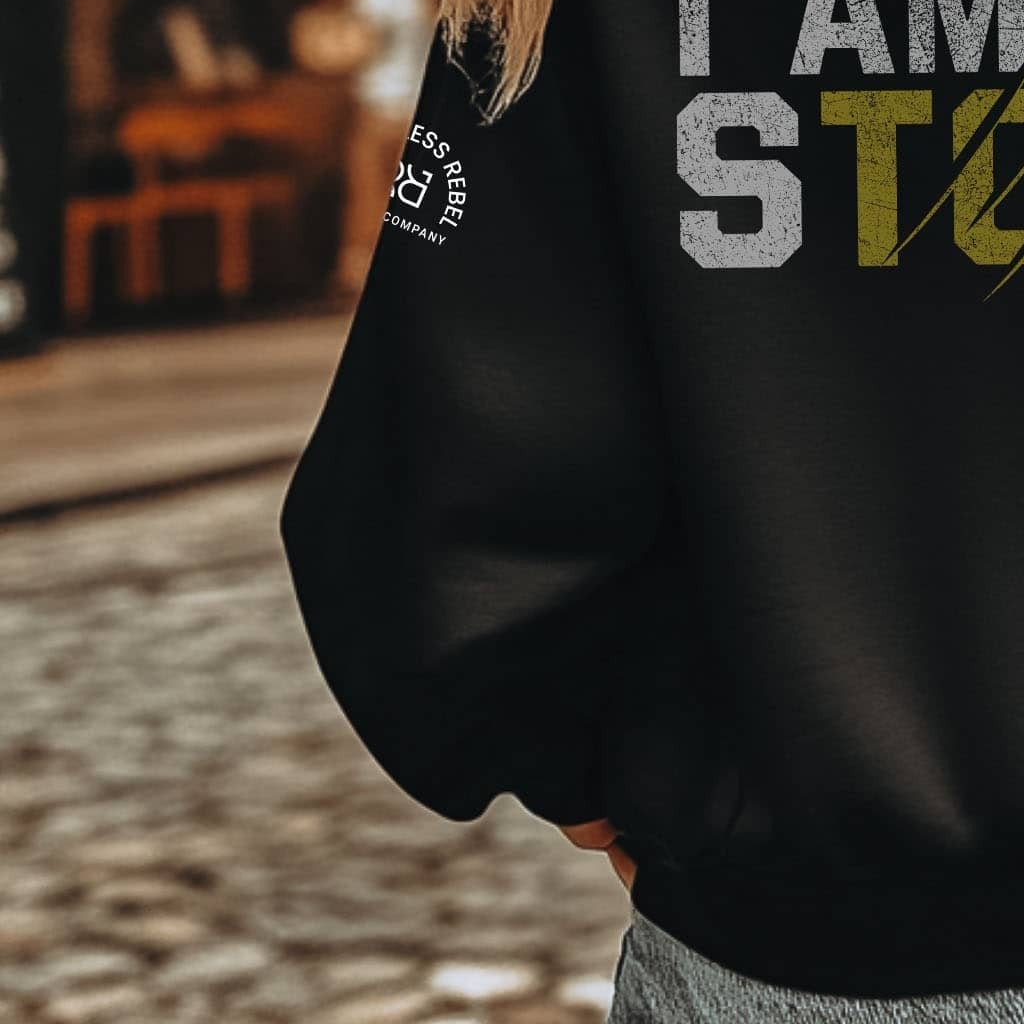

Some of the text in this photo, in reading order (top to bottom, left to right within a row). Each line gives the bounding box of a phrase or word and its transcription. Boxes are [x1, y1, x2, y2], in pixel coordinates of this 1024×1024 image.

[407, 124, 450, 159] ESS
[439, 160, 467, 227] REBEL
[383, 211, 447, 246] COMPANY
